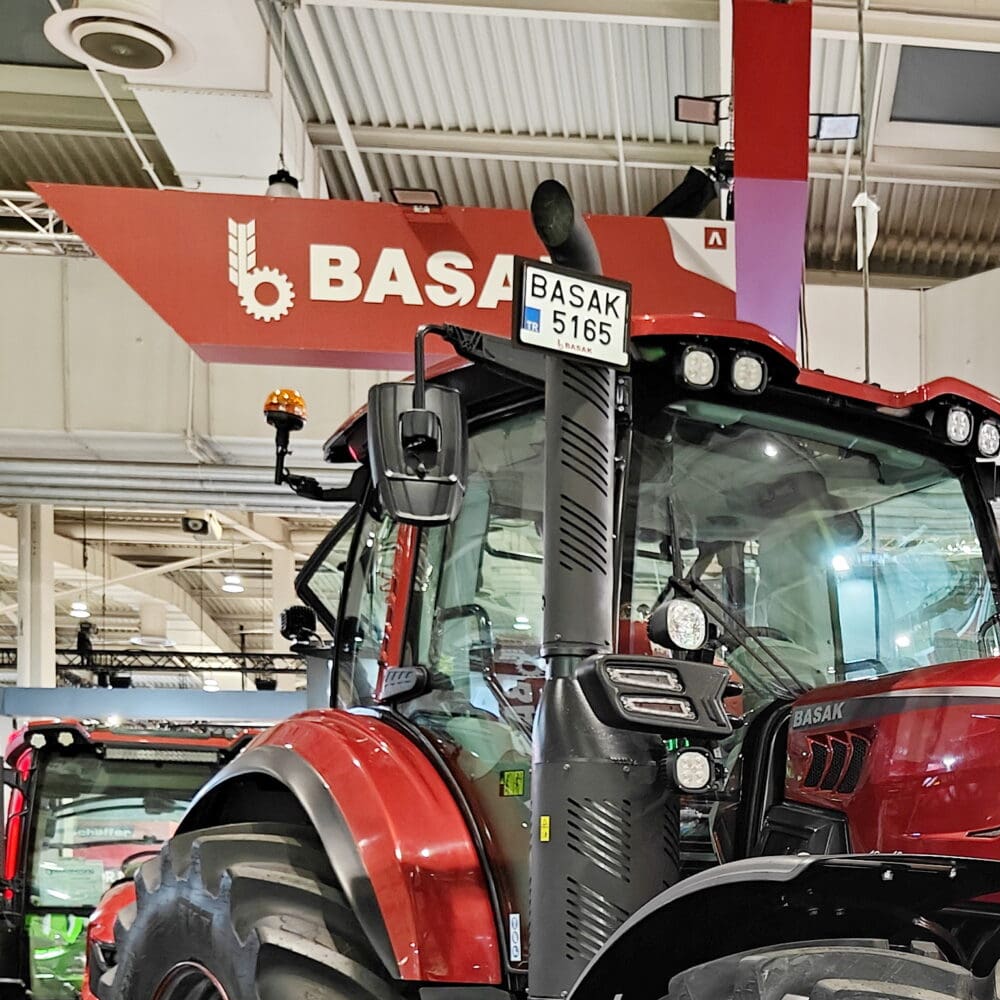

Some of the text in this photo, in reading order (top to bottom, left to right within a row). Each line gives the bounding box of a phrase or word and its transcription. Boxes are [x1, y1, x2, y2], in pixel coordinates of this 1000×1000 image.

[308, 243, 516, 309] BASA
[531, 273, 621, 320] BASAK
[526, 321, 540, 333] TR
[553, 310, 612, 346] 5165
[565, 342, 592, 353] BASAK
[793, 702, 846, 728] BASAK
